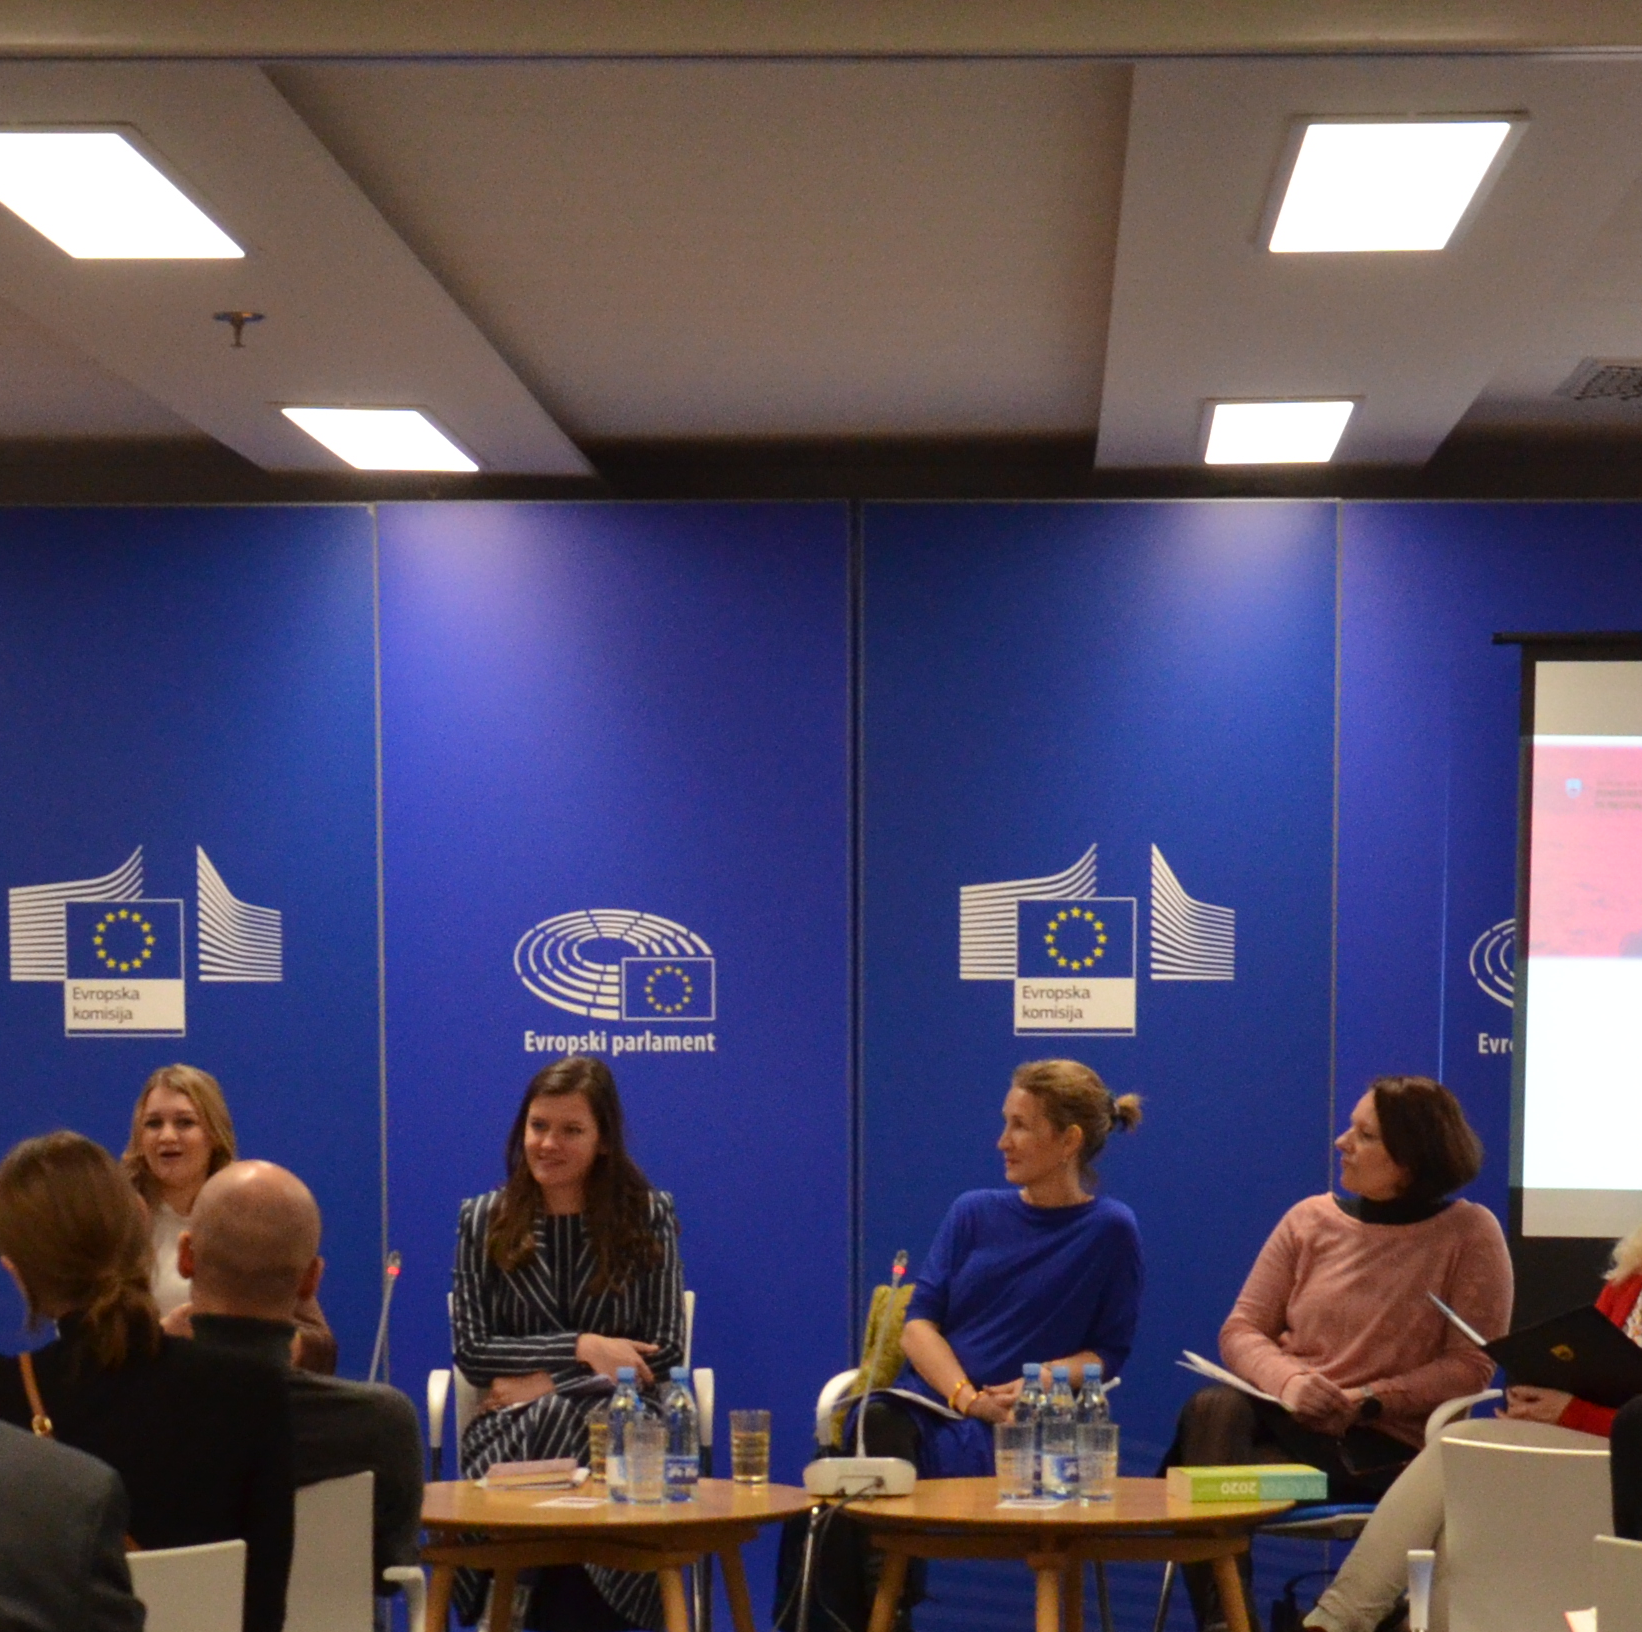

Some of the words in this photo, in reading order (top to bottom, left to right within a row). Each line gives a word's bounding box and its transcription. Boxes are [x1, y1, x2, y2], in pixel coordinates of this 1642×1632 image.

[72, 986, 140, 1003] Evropska
[1022, 985, 1091, 1002] Evropska
[72, 1006, 134, 1024] komisija
[1022, 1004, 1084, 1022] komisija
[524, 1029, 607, 1056] Evropski
[612, 1029, 716, 1057] parlament
[1478, 1032, 1513, 1054] Evr
